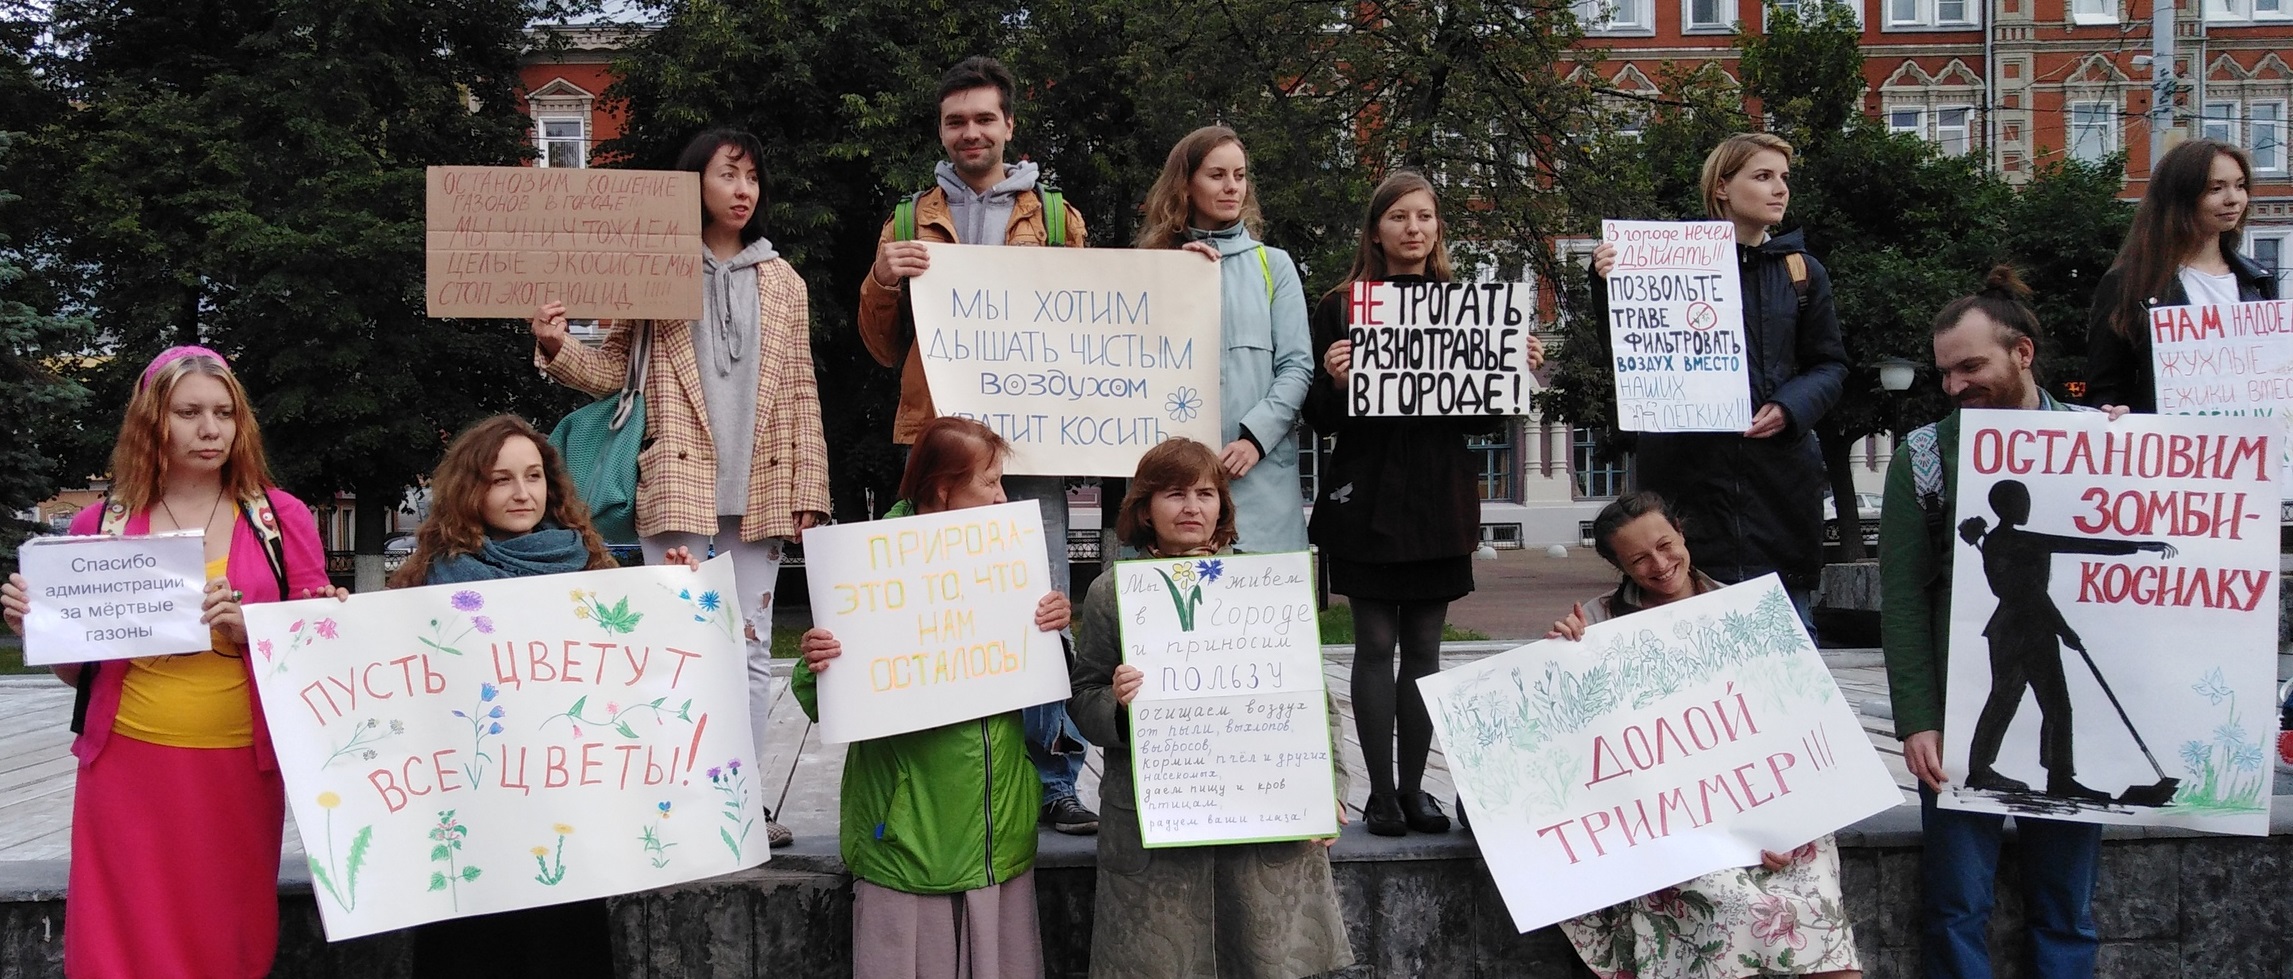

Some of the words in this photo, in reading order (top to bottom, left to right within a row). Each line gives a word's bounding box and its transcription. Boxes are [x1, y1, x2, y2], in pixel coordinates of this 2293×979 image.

[587, 174, 679, 197] КОШЕНИЕ
[452, 195, 530, 214] ГАЗОНОВ
[450, 216, 491, 248] МЫ
[503, 216, 679, 249] УНИЧТОЖАЕМ
[1624, 228, 1679, 253] городе
[447, 251, 527, 280] ЦЕЛЫЕ
[544, 253, 695, 279] ЭКОСИСТЕМЫ
[439, 282, 492, 305] СТОП
[1610, 275, 1724, 302] ПОЗВОЛЬТЕ
[952, 288, 1009, 320] МЫ
[1033, 289, 1149, 325] ХОТИМ
[1349, 281, 1385, 325] НЕ
[1392, 282, 1523, 326] ТРОГАТЬ
[1611, 308, 1670, 329] ТРАВЕ
[2153, 305, 2225, 343] НАМ
[2231, 302, 2293, 336] НАДОЕ
[927, 327, 1058, 363] ДЫШАТЬ
[1070, 333, 1193, 370] ЧИСТЫМ
[1350, 327, 1519, 372] РАЗНОТРАВЬЕ
[1623, 331, 1741, 355] ФИЛЬТРОВАТЬ
[1617, 355, 1674, 373] ВОЗДУХ
[1684, 356, 1740, 373] ВМЕСТО
[2158, 346, 2267, 378] ЖУХЛЫЕ
[1353, 372, 1370, 416] В
[1619, 375, 1686, 400] НАШИХ
[1972, 428, 2272, 482] ОСТАНОВИМ
[2072, 486, 2261, 541] ЗОМБИ-
[71, 554, 156, 573] Спасибо
[46, 578, 185, 598] администрации
[833, 578, 906, 615] ЭТО
[921, 570, 964, 605] ТО,
[974, 560, 1028, 593] ЧТО
[1120, 573, 1160, 595] Мы
[1225, 567, 1304, 589] живем
[2076, 561, 2273, 612] КОСИЛКУ
[60, 607, 81, 620] за
[89, 600, 174, 620] мёртвые
[1135, 606, 1147, 626] в
[86, 626, 152, 642] газоны
[918, 608, 975, 645] НАМ
[1132, 645, 1147, 656] и
[1166, 636, 1291, 662] приносим
[299, 653, 447, 727] ПУСТЬ
[491, 640, 703, 691] ЦВЕТУТ
[1139, 705, 1230, 722] очищаем
[1246, 698, 1308, 721] воздух
[1136, 727, 1158, 738] от
[1584, 680, 1760, 791] ДОЛОЙ
[367, 749, 463, 815] ВСЕ
[499, 712, 709, 797] ЦВЕТЫ!
[1216, 751, 1257, 765] пчёл
[1263, 754, 1272, 763] и
[1276, 751, 1327, 767] других
[1144, 785, 1183, 803] даем
[1190, 783, 1225, 797] пищу
[1258, 778, 1286, 796] кров
[1150, 816, 1198, 833] радуем
[1208, 815, 1248, 825] ваши
